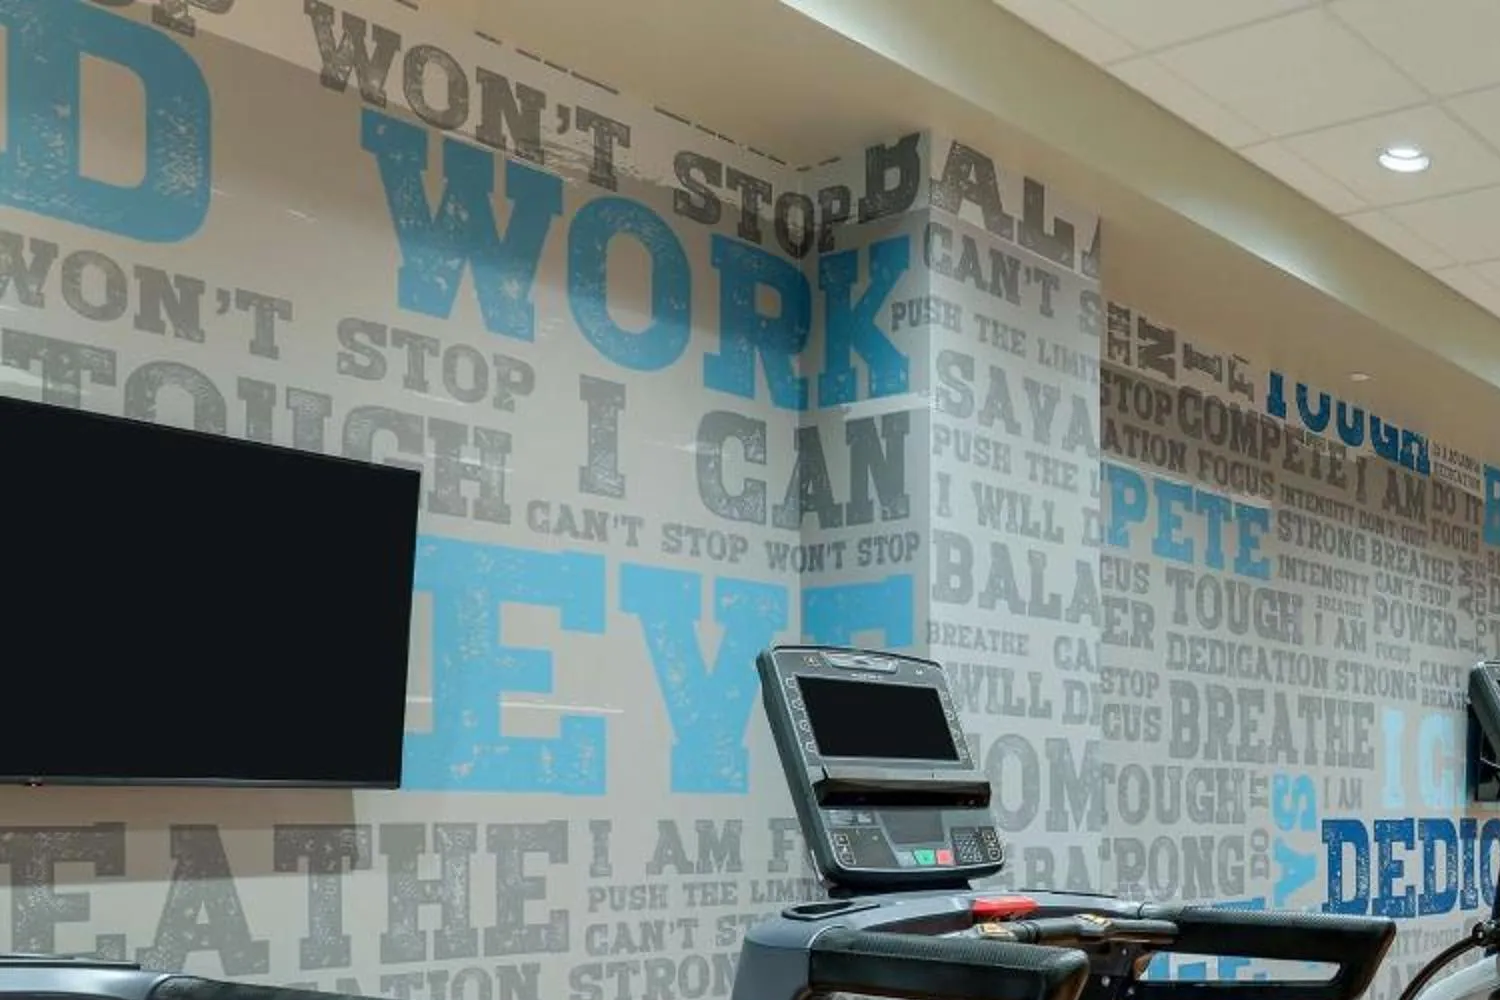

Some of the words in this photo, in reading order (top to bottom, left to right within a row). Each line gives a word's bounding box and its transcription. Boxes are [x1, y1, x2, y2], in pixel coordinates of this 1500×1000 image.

[303, 1, 631, 192] WON'T
[673, 150, 852, 260] STOP
[360, 106, 911, 412] WORK
[336, 316, 536, 413] STOP
[974, 313, 1027, 359] THE
[578, 374, 626, 498] I
[695, 408, 911, 532] CAN
[1024, 449, 1079, 494] THE
[1177, 385, 1348, 489] COMPETE
[526, 499, 646, 549] CAN'T
[661, 522, 749, 565] STOP
[764, 541, 848, 575] WON'T
[856, 530, 921, 567] STOP
[1277, 507, 1367, 564] STRONG
[926, 620, 1030, 657] BREATHE
[1164, 565, 1305, 646] TOUGH
[1165, 631, 1329, 693] DEDICATION
[1335, 660, 1418, 703] STRONG
[1168, 678, 1376, 771] BREATHE
[588, 819, 613, 879] I
[645, 818, 744, 876] AM
[587, 883, 669, 913] PUSH
[682, 881, 739, 907] THE
[584, 917, 700, 957] CAN'T
